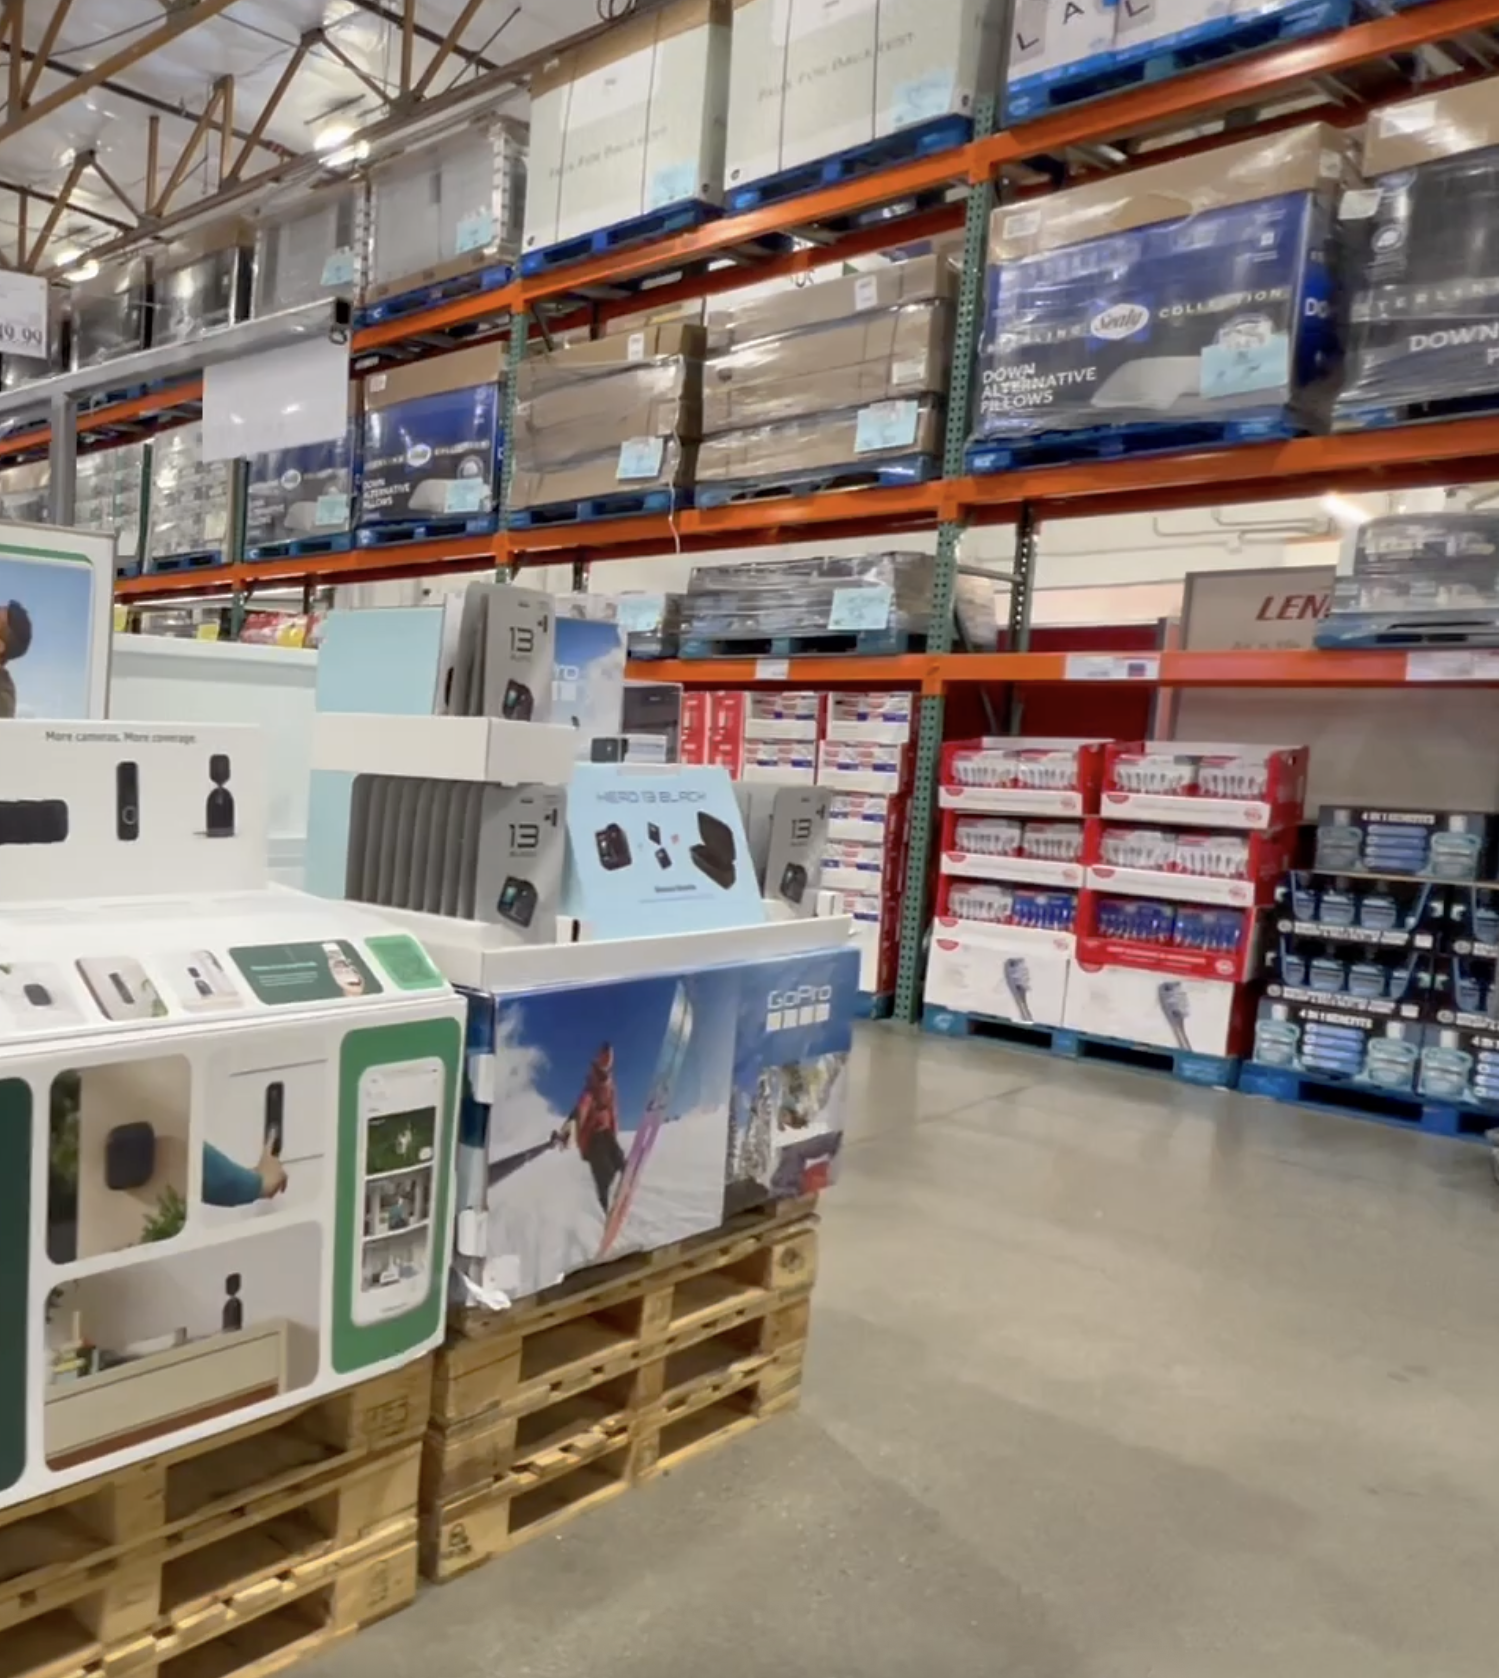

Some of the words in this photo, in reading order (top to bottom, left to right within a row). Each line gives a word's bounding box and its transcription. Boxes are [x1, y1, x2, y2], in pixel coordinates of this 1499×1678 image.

[1407, 321, 1499, 352] DOWN
[981, 367, 1098, 399] ALTERNATIVE
[983, 362, 1036, 385] DOWN
[980, 390, 1054, 415] PILLOWS
[509, 626, 535, 653] 13
[45, 731, 72, 743] More
[75, 732, 121, 743] cameras.
[123, 732, 149, 744] More
[508, 823, 540, 849] 13
[790, 818, 812, 839] 13
[767, 985, 832, 1010] GoPro
